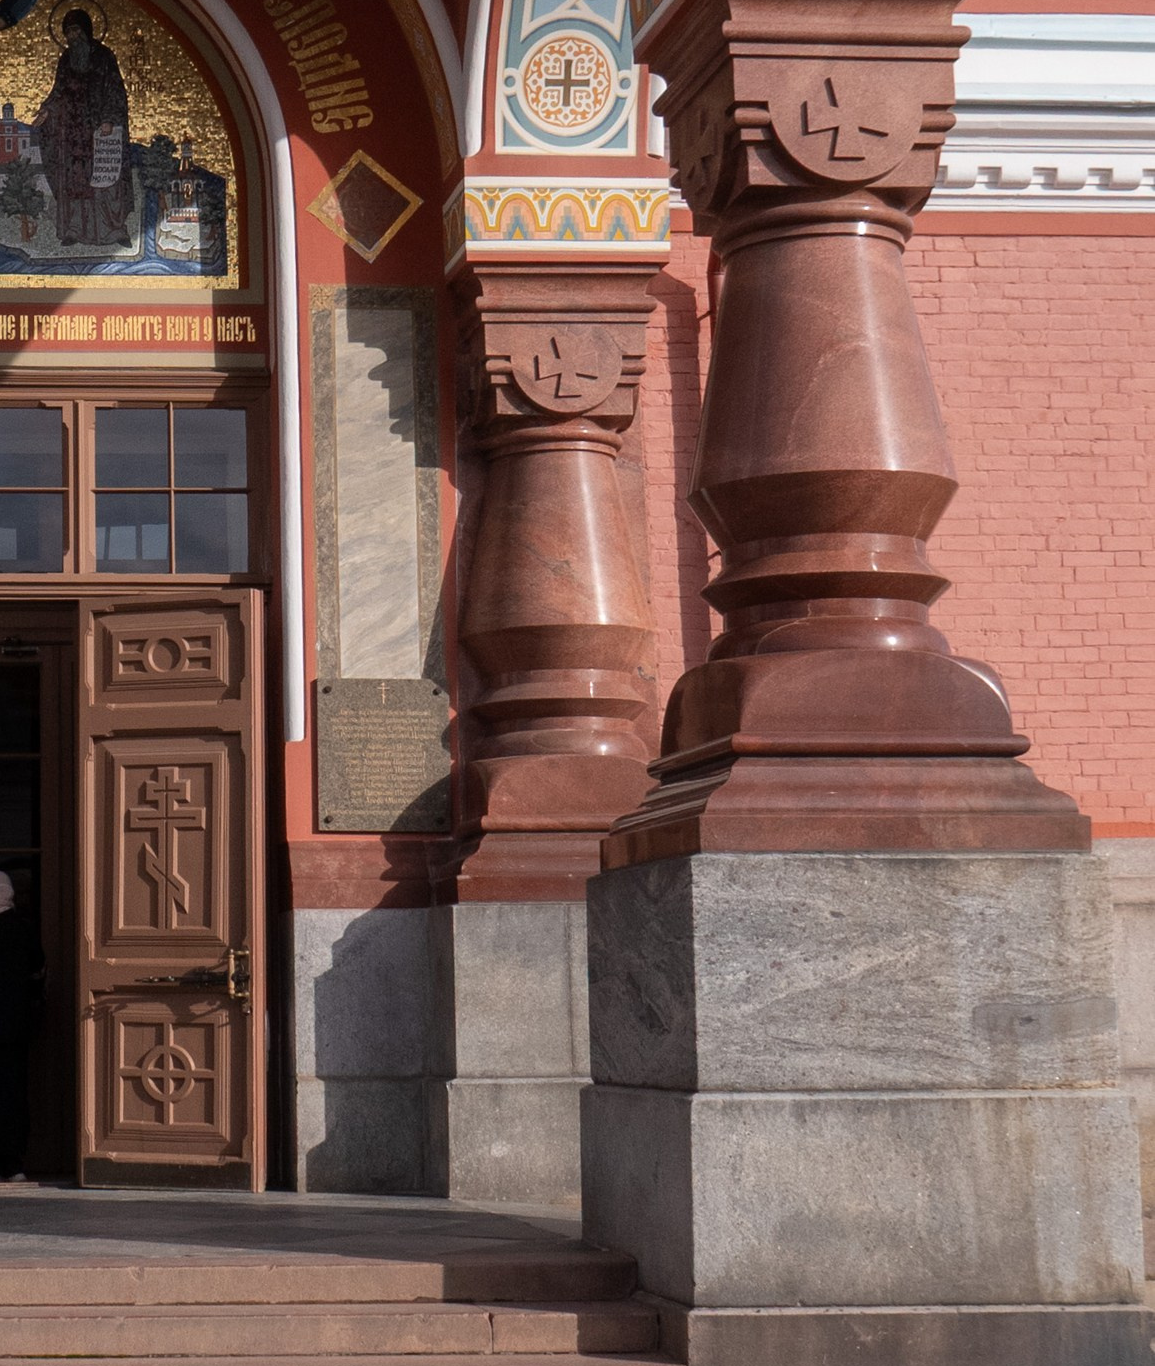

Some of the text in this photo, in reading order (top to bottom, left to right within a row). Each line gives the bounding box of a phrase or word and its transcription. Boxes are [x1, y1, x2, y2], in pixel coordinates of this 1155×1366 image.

[19, 315, 29, 341] И
[33, 314, 97, 341] ГЕРМАНЕ
[102, 315, 162, 341] МОЛИТЕ
[166, 315, 200, 342] БОГА
[216, 315, 257, 343] НАСЪ
